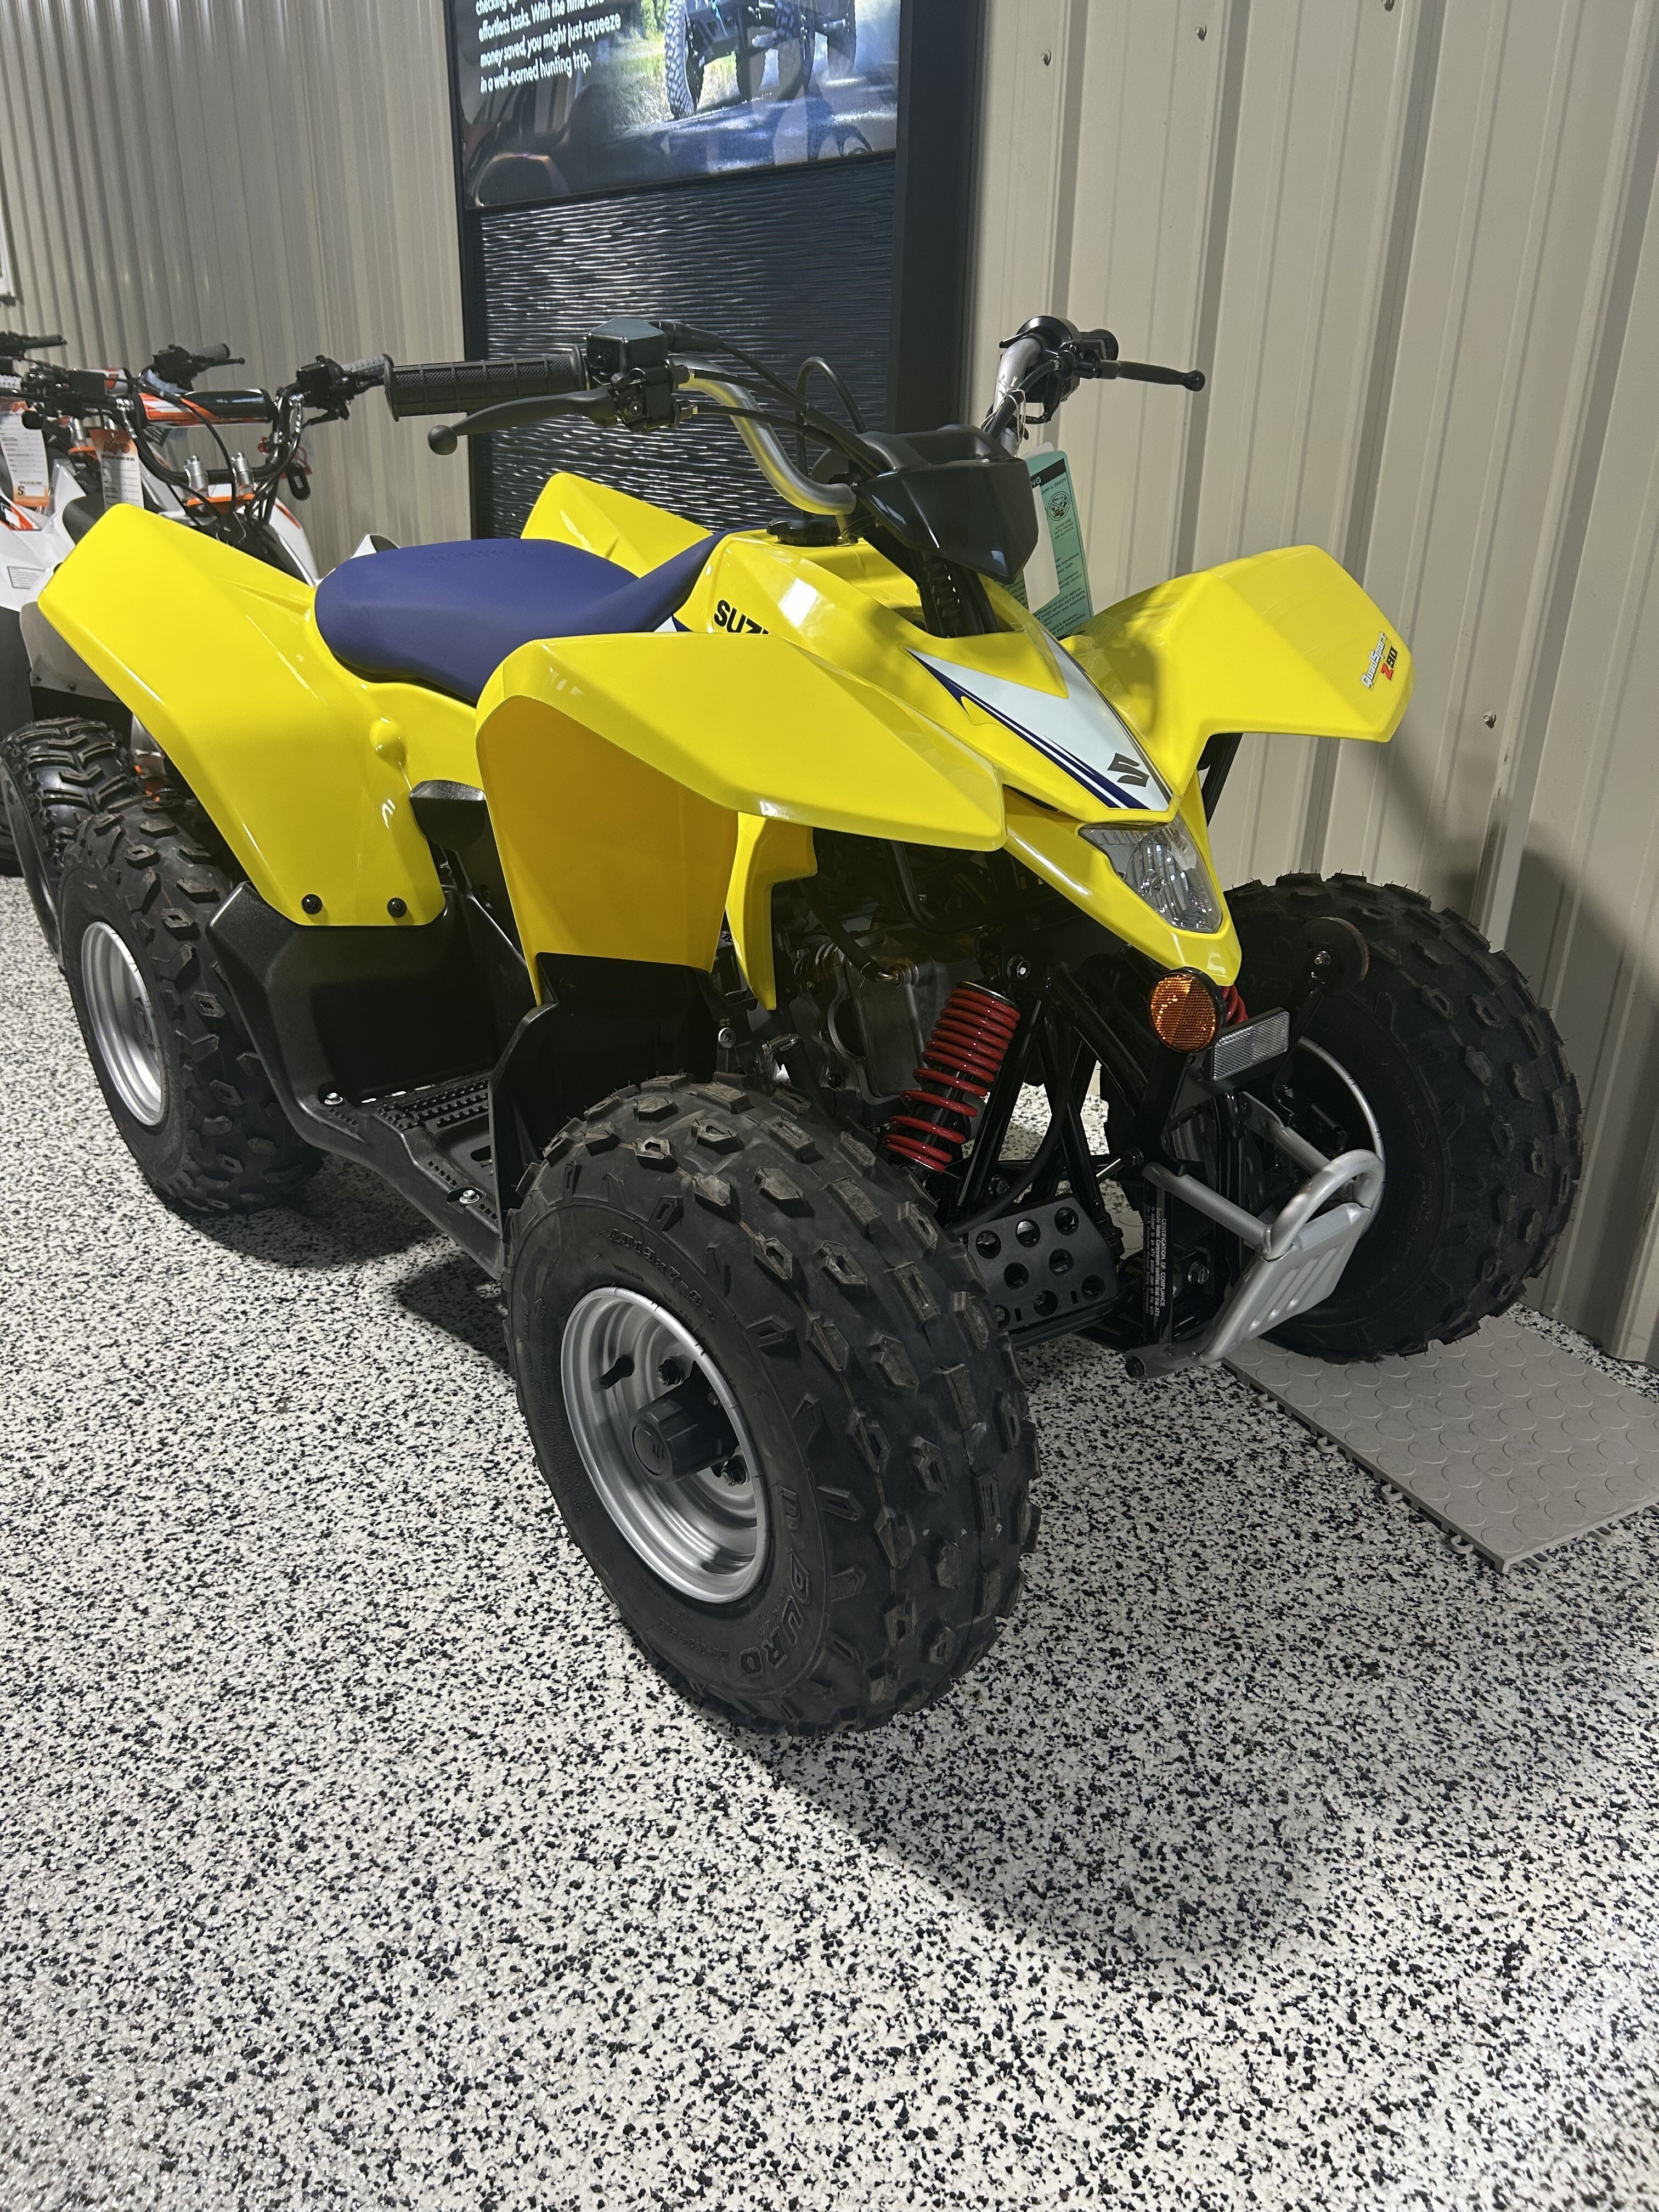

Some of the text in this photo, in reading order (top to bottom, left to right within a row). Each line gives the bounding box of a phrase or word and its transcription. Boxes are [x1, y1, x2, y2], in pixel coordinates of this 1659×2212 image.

[478, 15, 510, 42] effortless
[510, 7, 531, 31] tasks.
[531, 1, 550, 24] With
[551, 0, 565, 18] the
[480, 13, 621, 68] money saved, you might just squeeze
[480, 49, 591, 94] in a well-earned hunting trip.
[714, 599, 769, 635] SUZ
[1380, 645, 1398, 681] Z90
[739, 1548, 810, 1677] DURO
